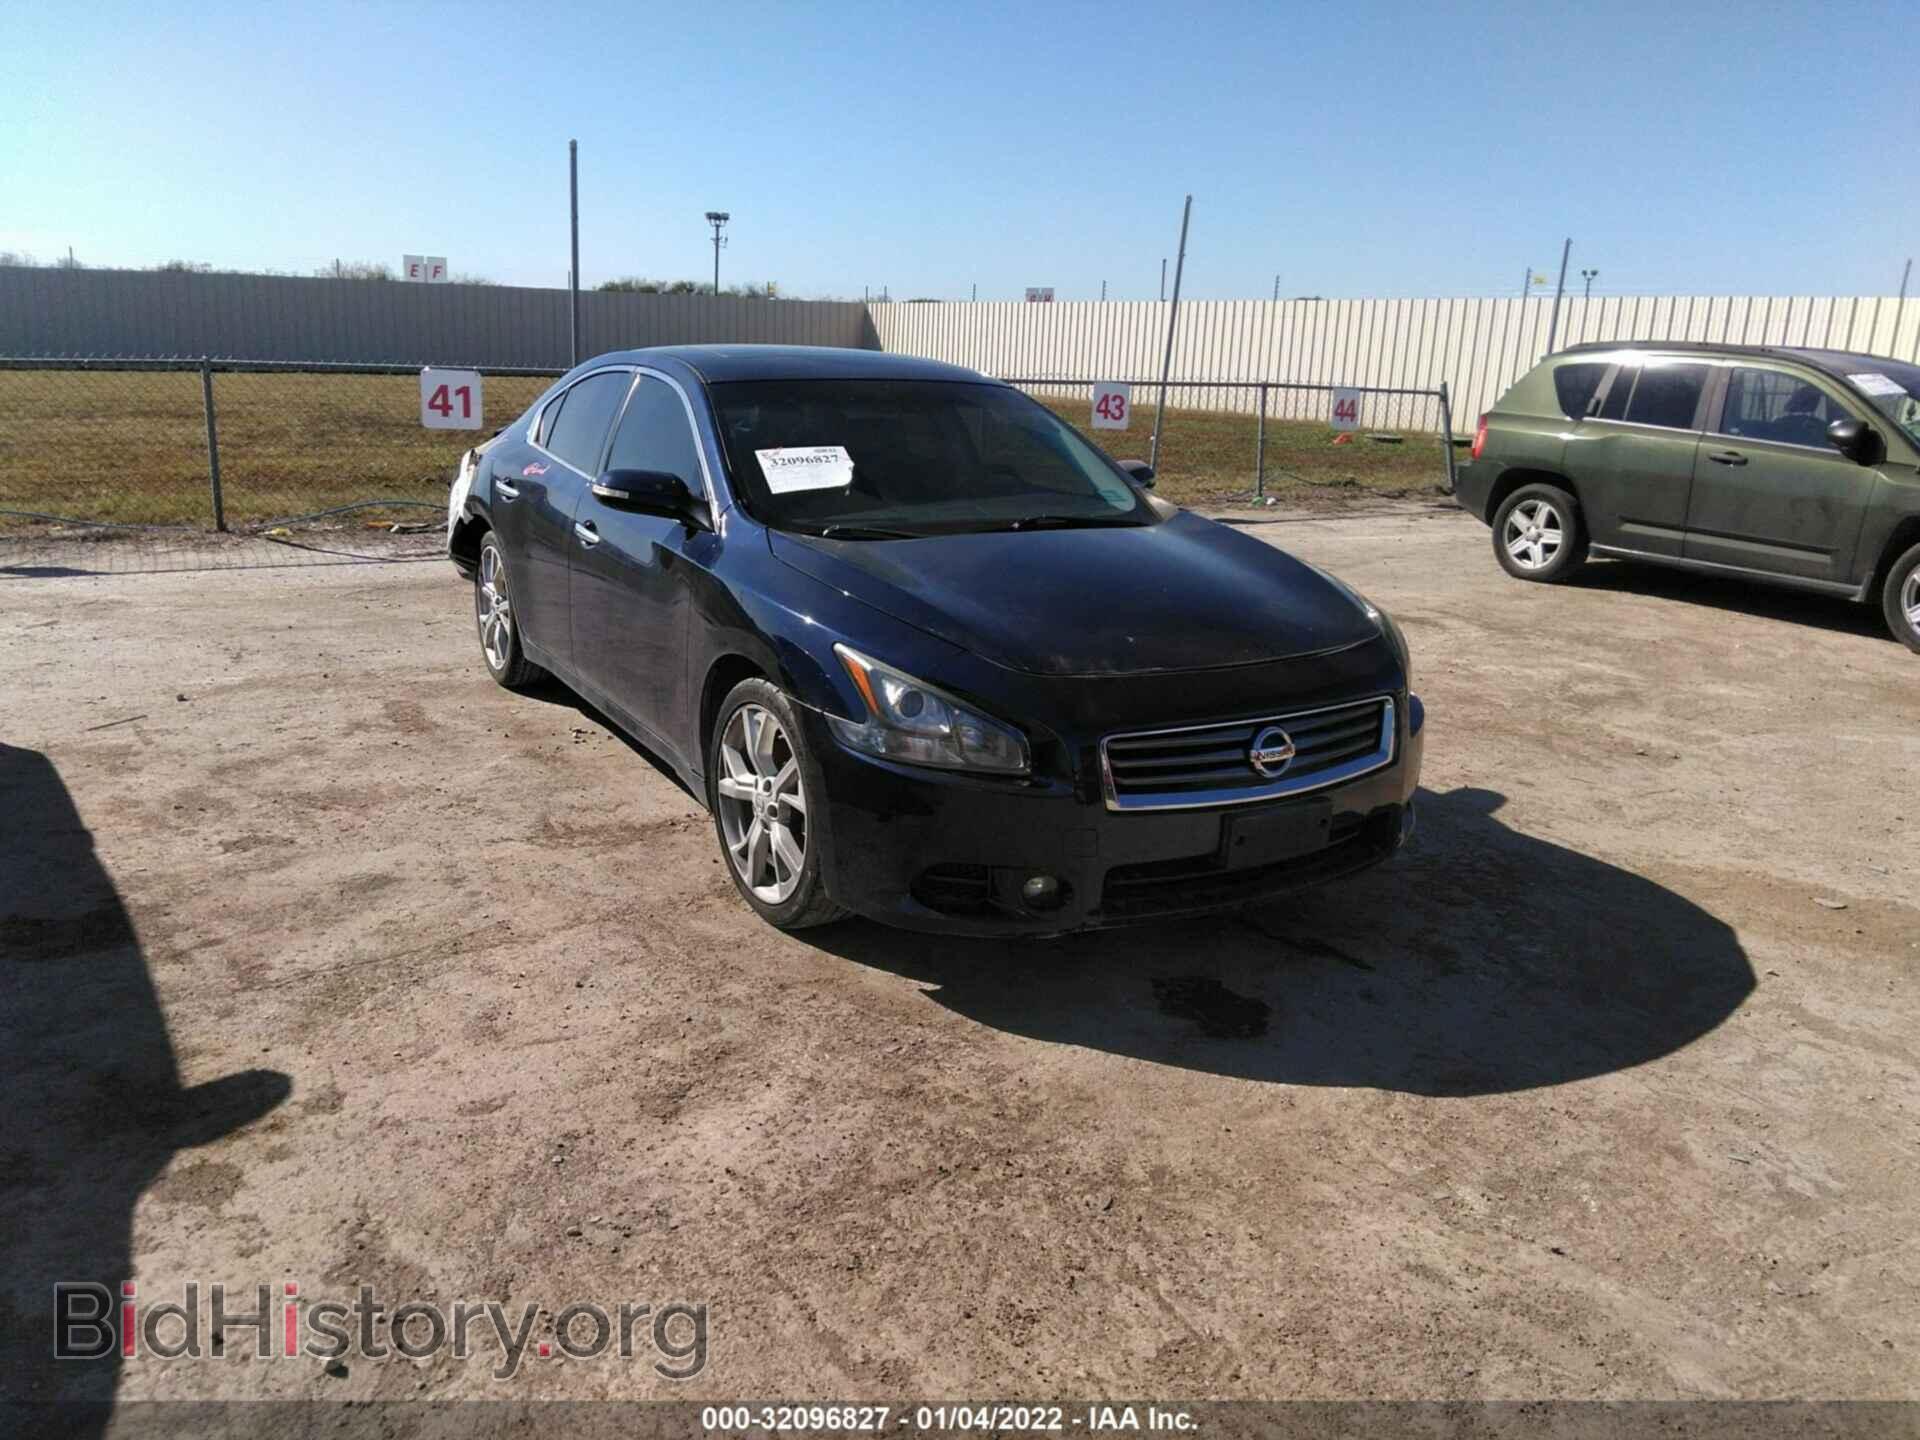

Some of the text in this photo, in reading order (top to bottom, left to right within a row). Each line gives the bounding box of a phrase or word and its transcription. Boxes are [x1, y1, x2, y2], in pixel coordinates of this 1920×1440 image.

[410, 264, 419, 278] E
[432, 265, 442, 279] F
[428, 384, 471, 418] 41
[1096, 393, 1125, 421] 43
[1335, 399, 1356, 422] 44
[770, 454, 839, 468] 32096827
